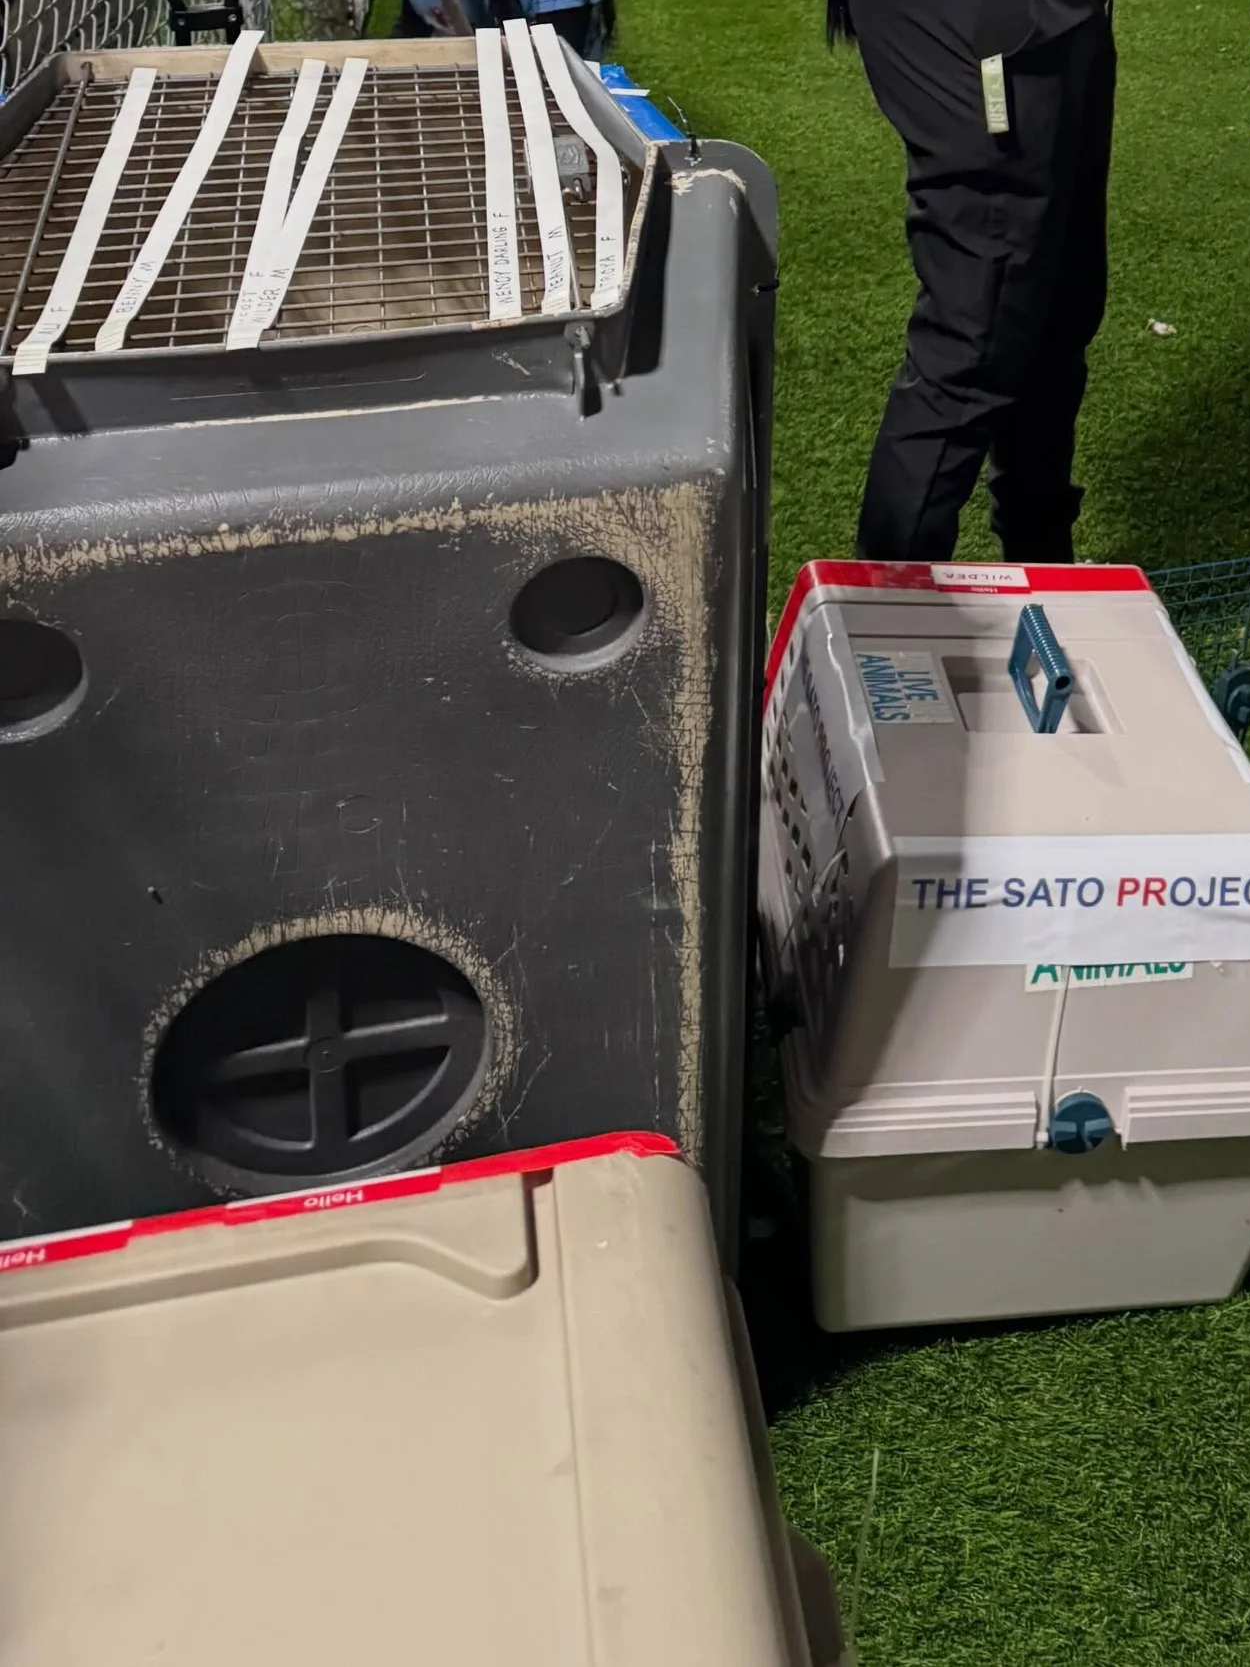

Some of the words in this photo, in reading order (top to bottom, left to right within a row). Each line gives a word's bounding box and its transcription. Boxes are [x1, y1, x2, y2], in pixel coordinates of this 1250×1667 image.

[856, 653, 911, 721] ANIMALS
[897, 670, 941, 702] LIVE
[911, 877, 989, 910] THE
[1001, 876, 1105, 908] SATO
[303, 1188, 365, 1209] Hello
